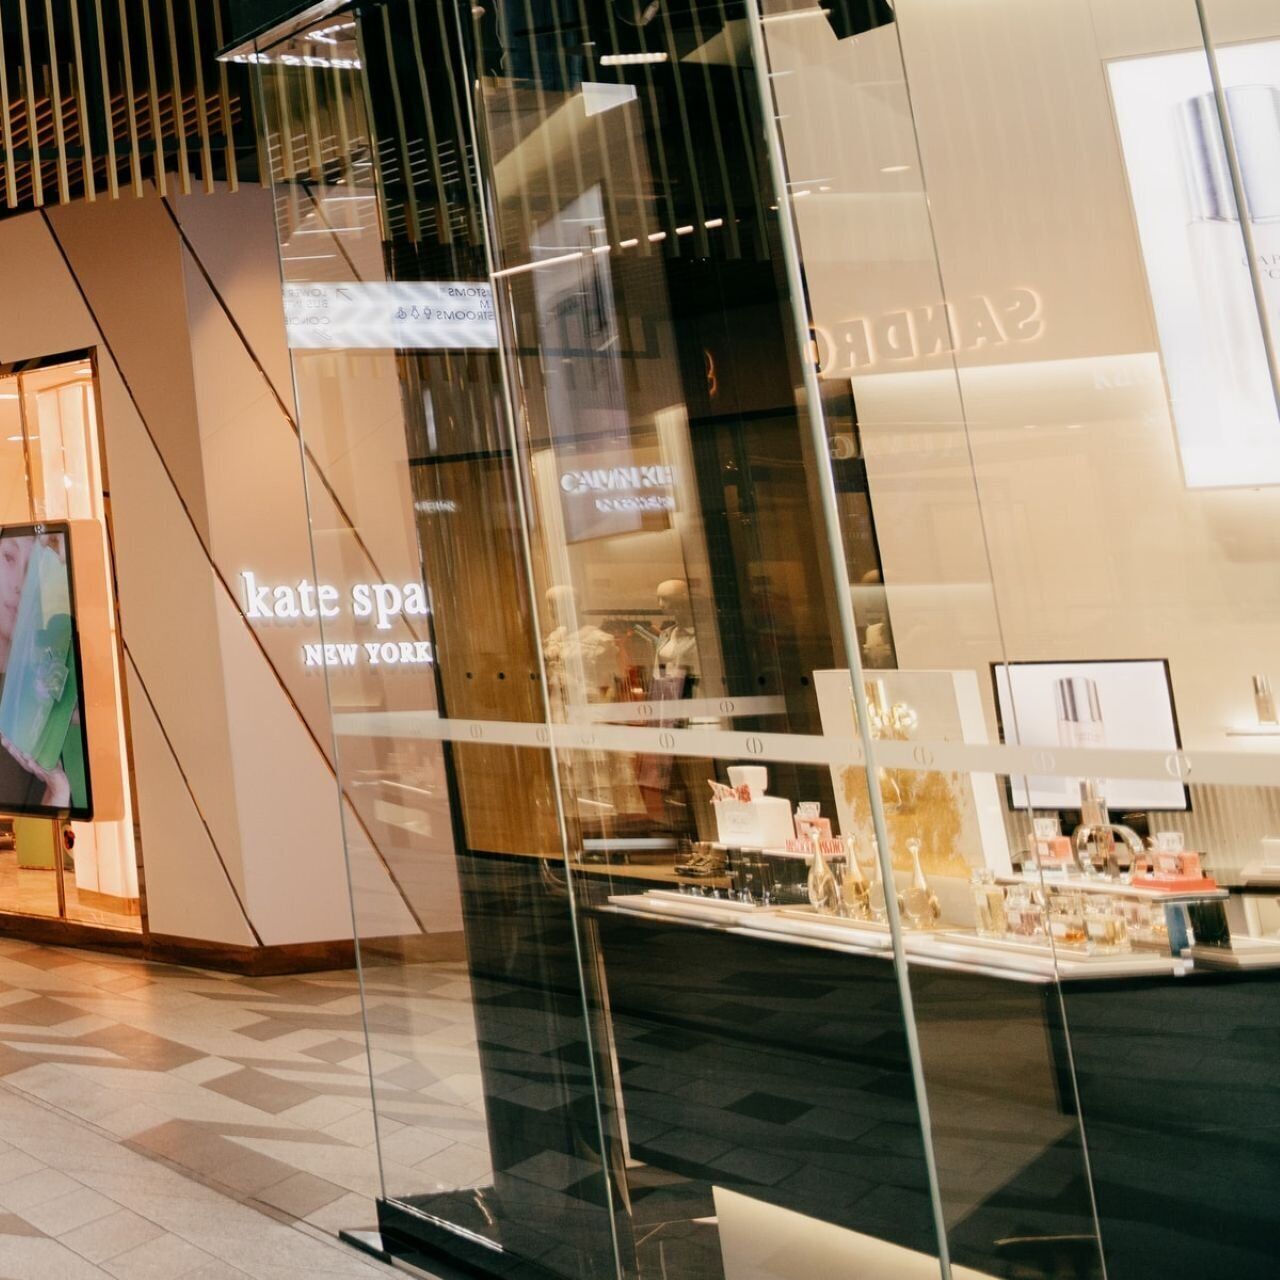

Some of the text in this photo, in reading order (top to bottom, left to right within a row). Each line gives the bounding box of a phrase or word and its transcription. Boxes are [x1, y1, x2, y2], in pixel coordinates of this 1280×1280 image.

[241, 571, 340, 618] kate
[303, 641, 434, 666] NEW YORK
